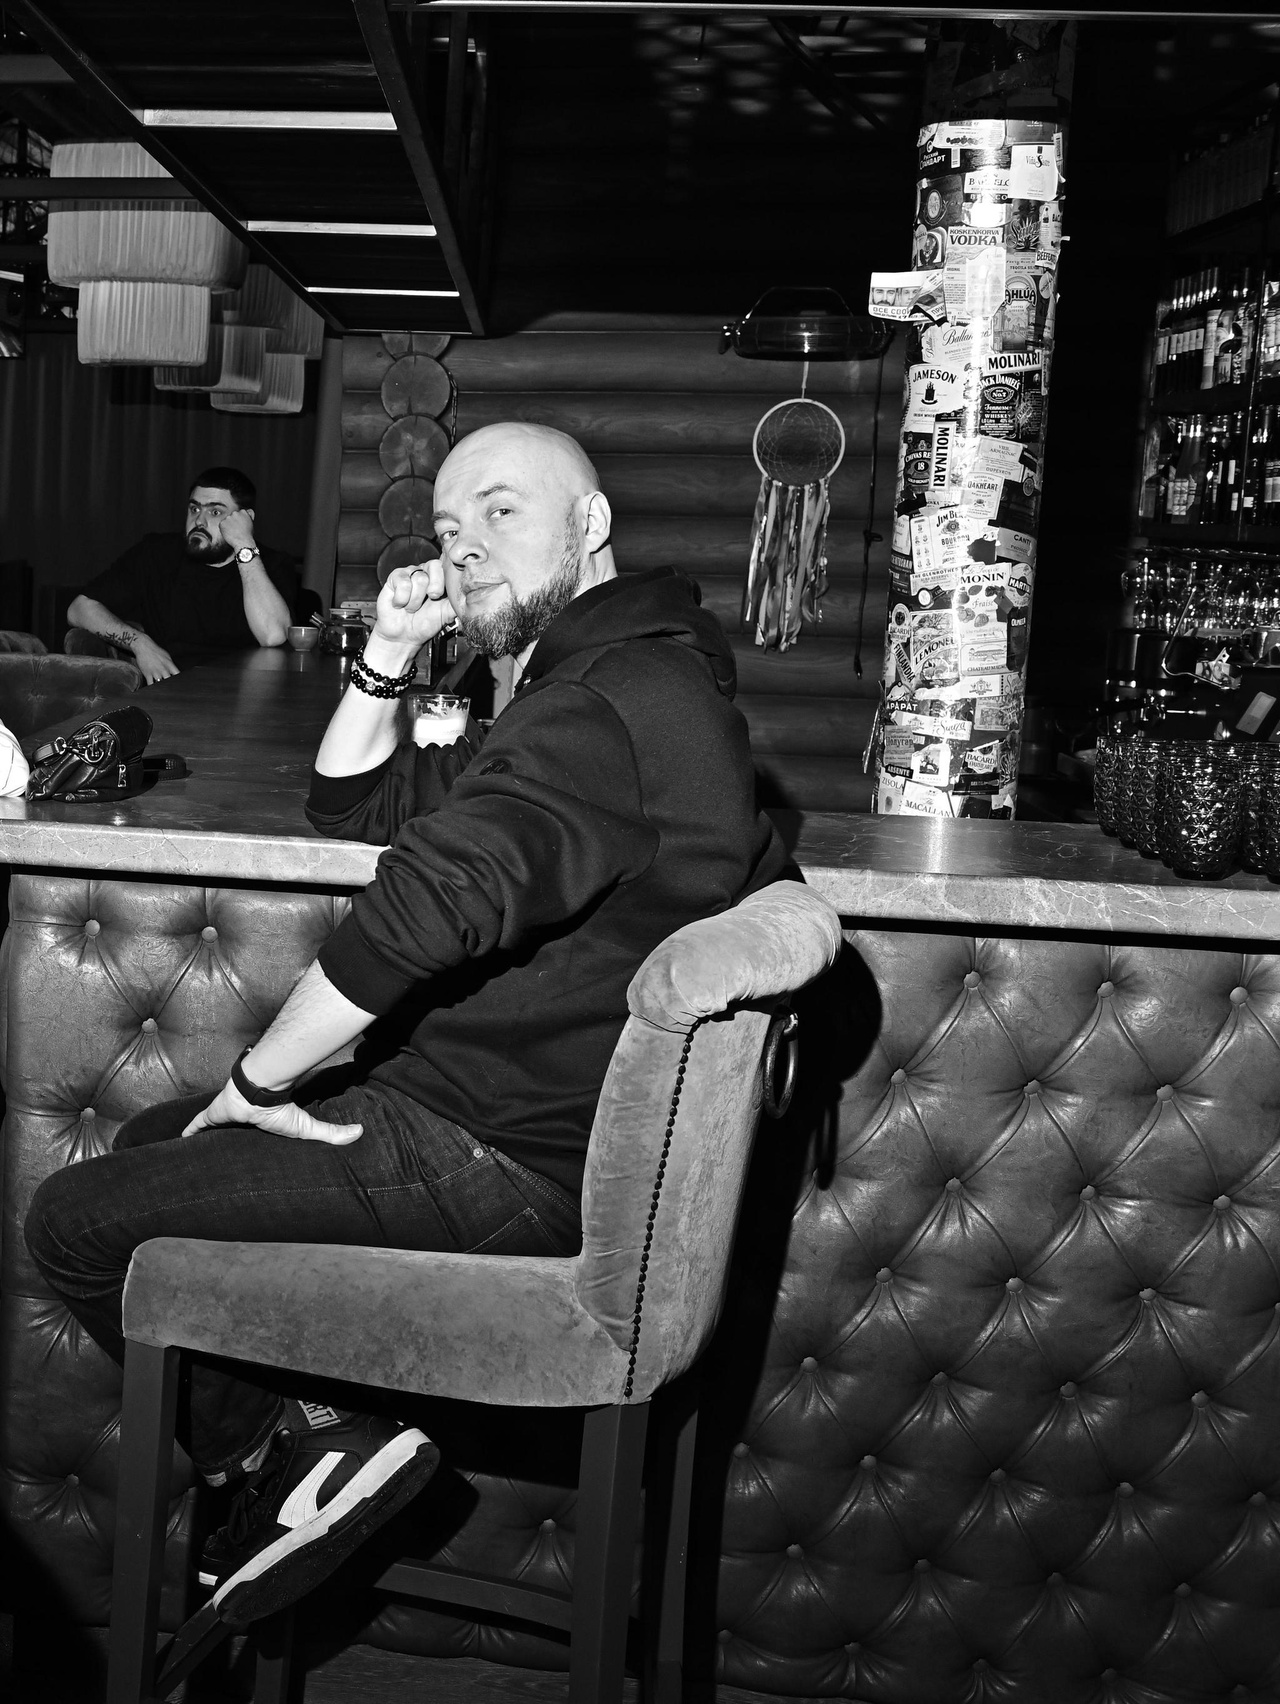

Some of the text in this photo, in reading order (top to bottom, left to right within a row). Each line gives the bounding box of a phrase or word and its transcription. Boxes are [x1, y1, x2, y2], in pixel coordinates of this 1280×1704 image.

[950, 228, 1000, 236] KOSKENKORVA
[950, 235, 997, 246] VODKA
[988, 351, 1041, 370] MOLINARI
[912, 369, 957, 384] JAMESON
[933, 426, 950, 487] MOLINARI
[917, 461, 925, 471] 18
[967, 480, 999, 492] OAKHEART
[936, 513, 949, 528] JIM
[960, 572, 1005, 584] MONIN
[893, 643, 916, 684] FINLANDIA
[886, 765, 910, 777] ABSENTE
[905, 799, 951, 818] MACALLAN
